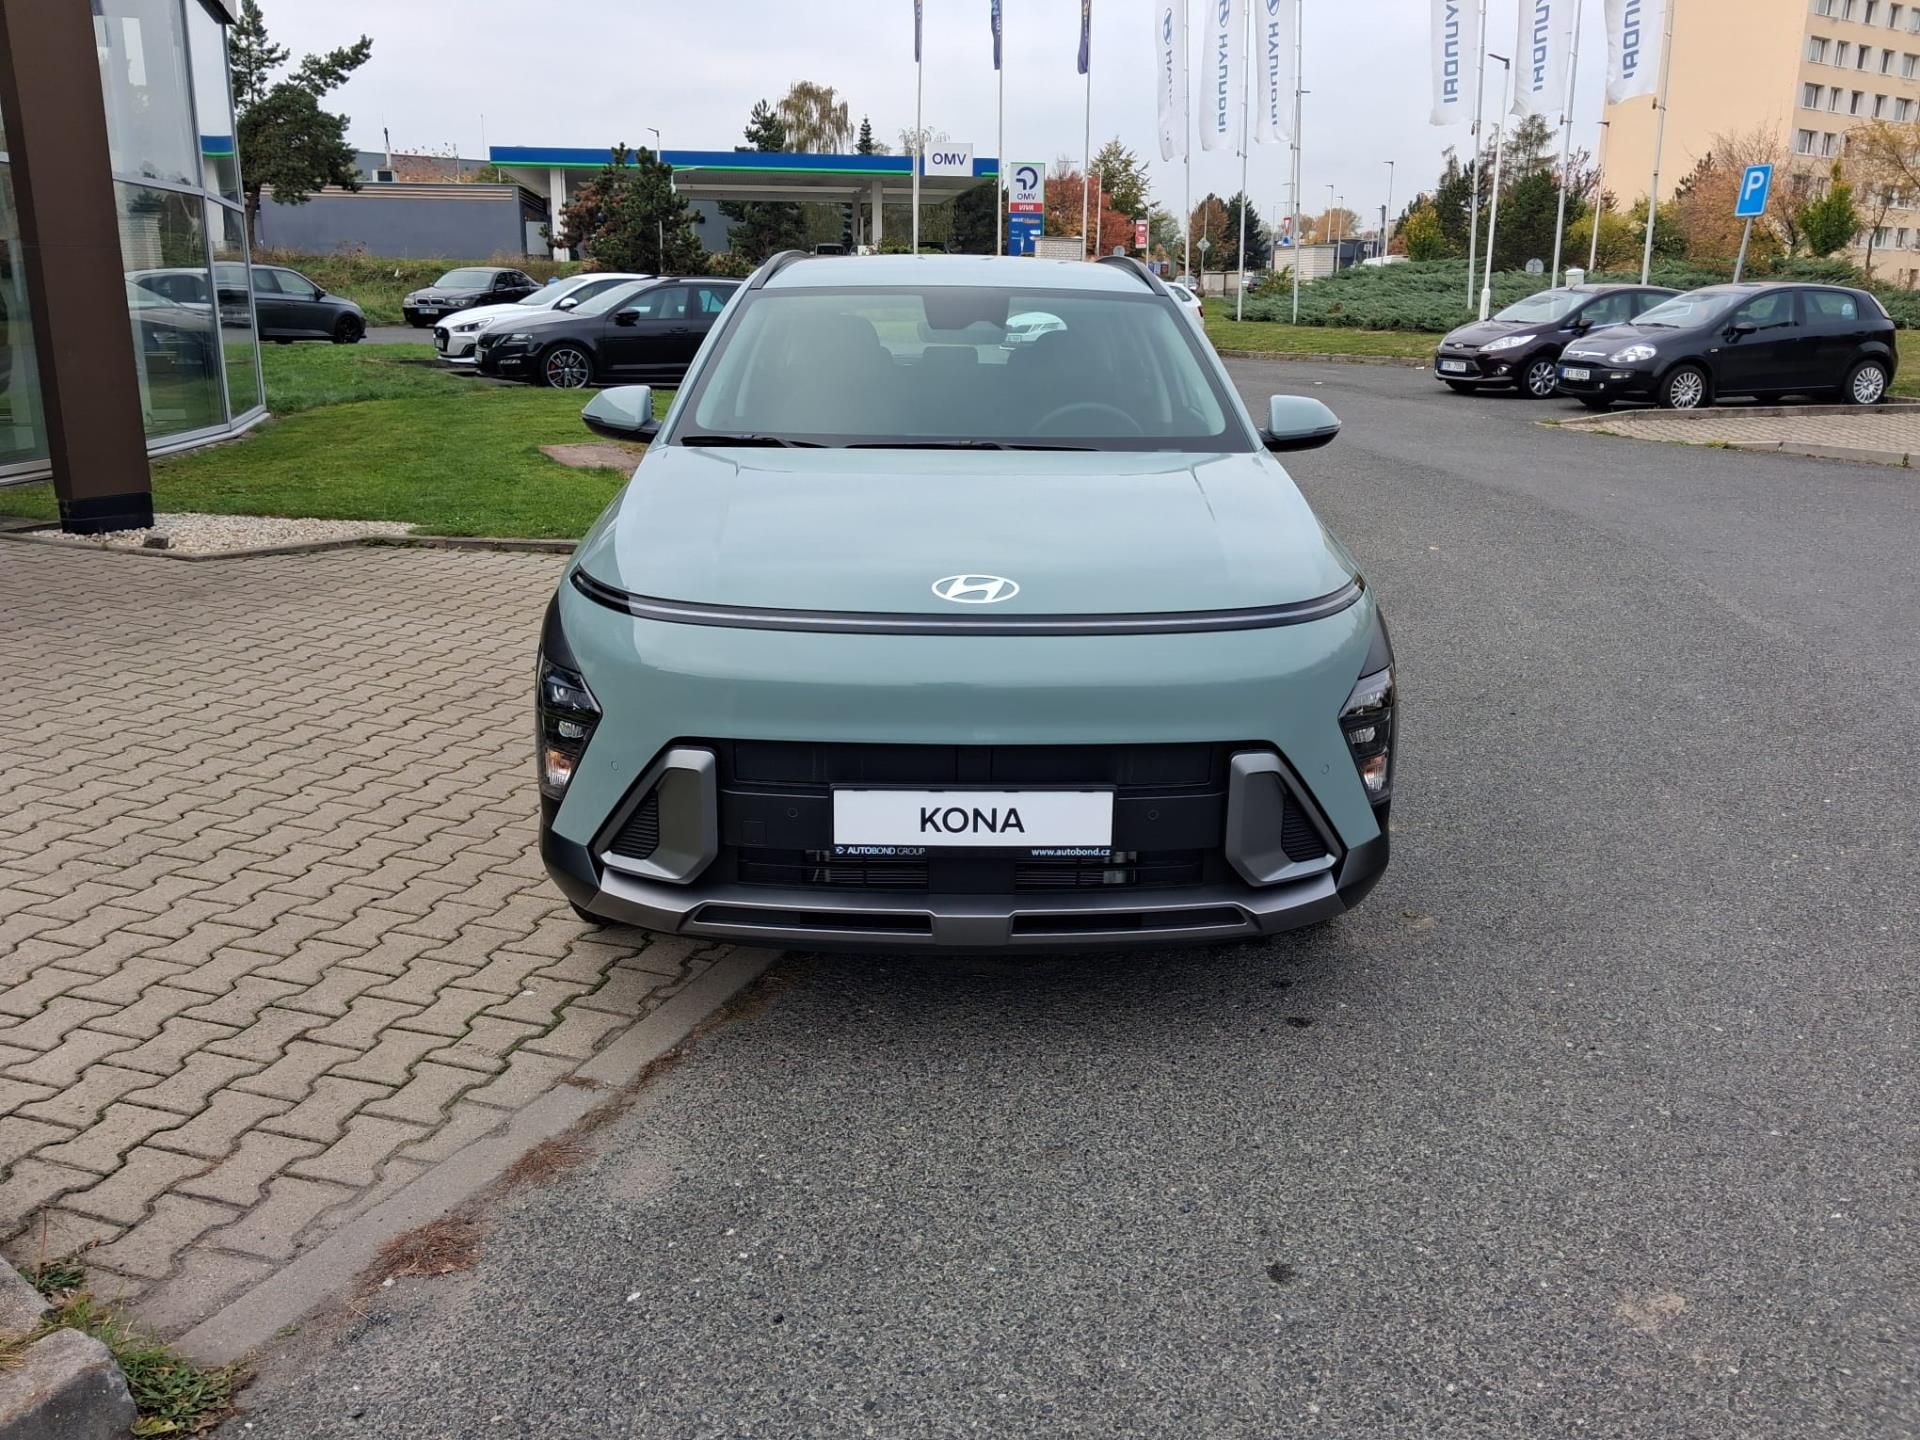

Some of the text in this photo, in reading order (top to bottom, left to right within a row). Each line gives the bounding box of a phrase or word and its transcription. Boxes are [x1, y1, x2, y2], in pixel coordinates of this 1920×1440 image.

[932, 152, 967, 166] OMV
[1744, 171, 1765, 201] P
[919, 807, 1025, 833] KONA
[847, 846, 926, 855] AUTOBOND GROUP
[1031, 847, 1111, 856] www.autobond.cz
